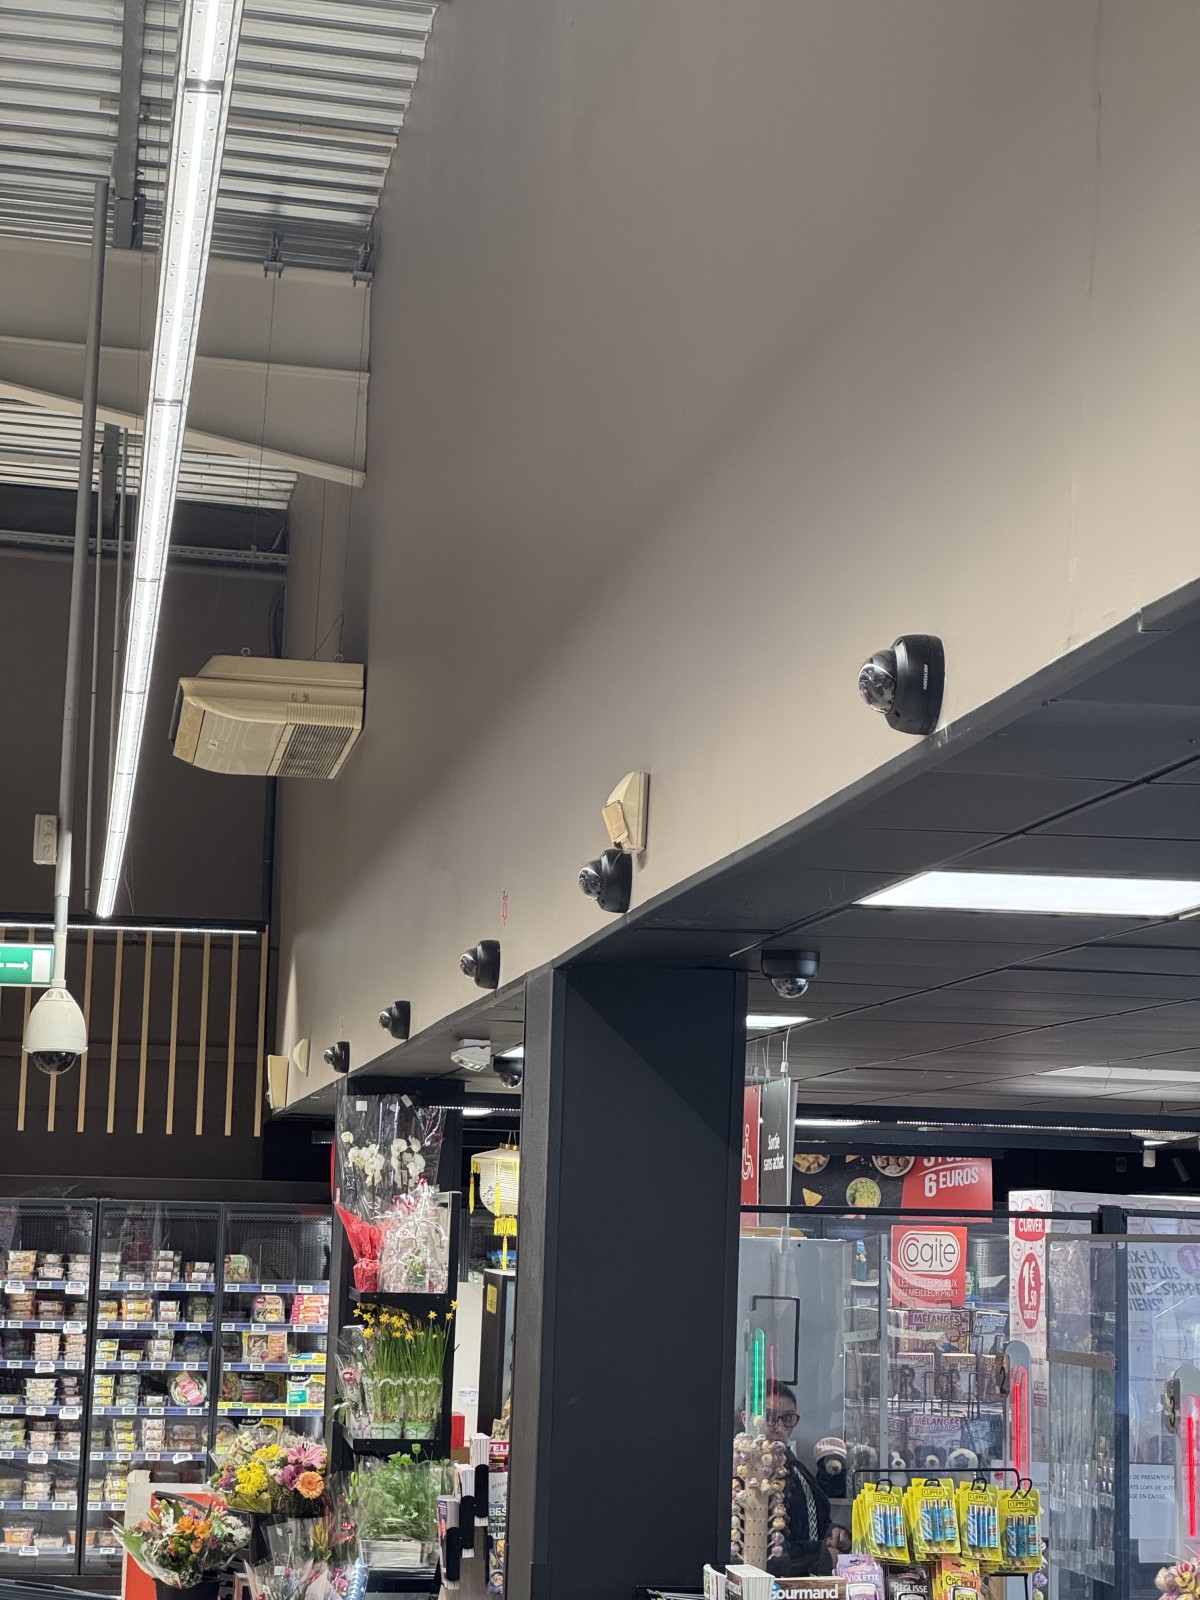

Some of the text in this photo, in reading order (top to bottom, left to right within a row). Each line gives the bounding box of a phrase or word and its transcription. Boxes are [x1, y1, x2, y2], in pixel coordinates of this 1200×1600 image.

[767, 1132, 780, 1151] Sortie
[763, 1152, 784, 1172] sans achat
[924, 1166, 979, 1198] 6 EUROS
[1018, 1218, 1043, 1233] CURVER
[902, 1236, 956, 1269] Cogite
[1148, 1266, 1180, 1280] PLUS
[874, 1494, 893, 1503] CLIPPER
[923, 1488, 944, 1496] CLIPPER
[969, 1493, 988, 1502] CLIPPER
[1009, 1500, 1030, 1508] CLIPPER
[842, 1572, 880, 1583] VIOLETTE
[945, 1575, 977, 1589] CACHOU
